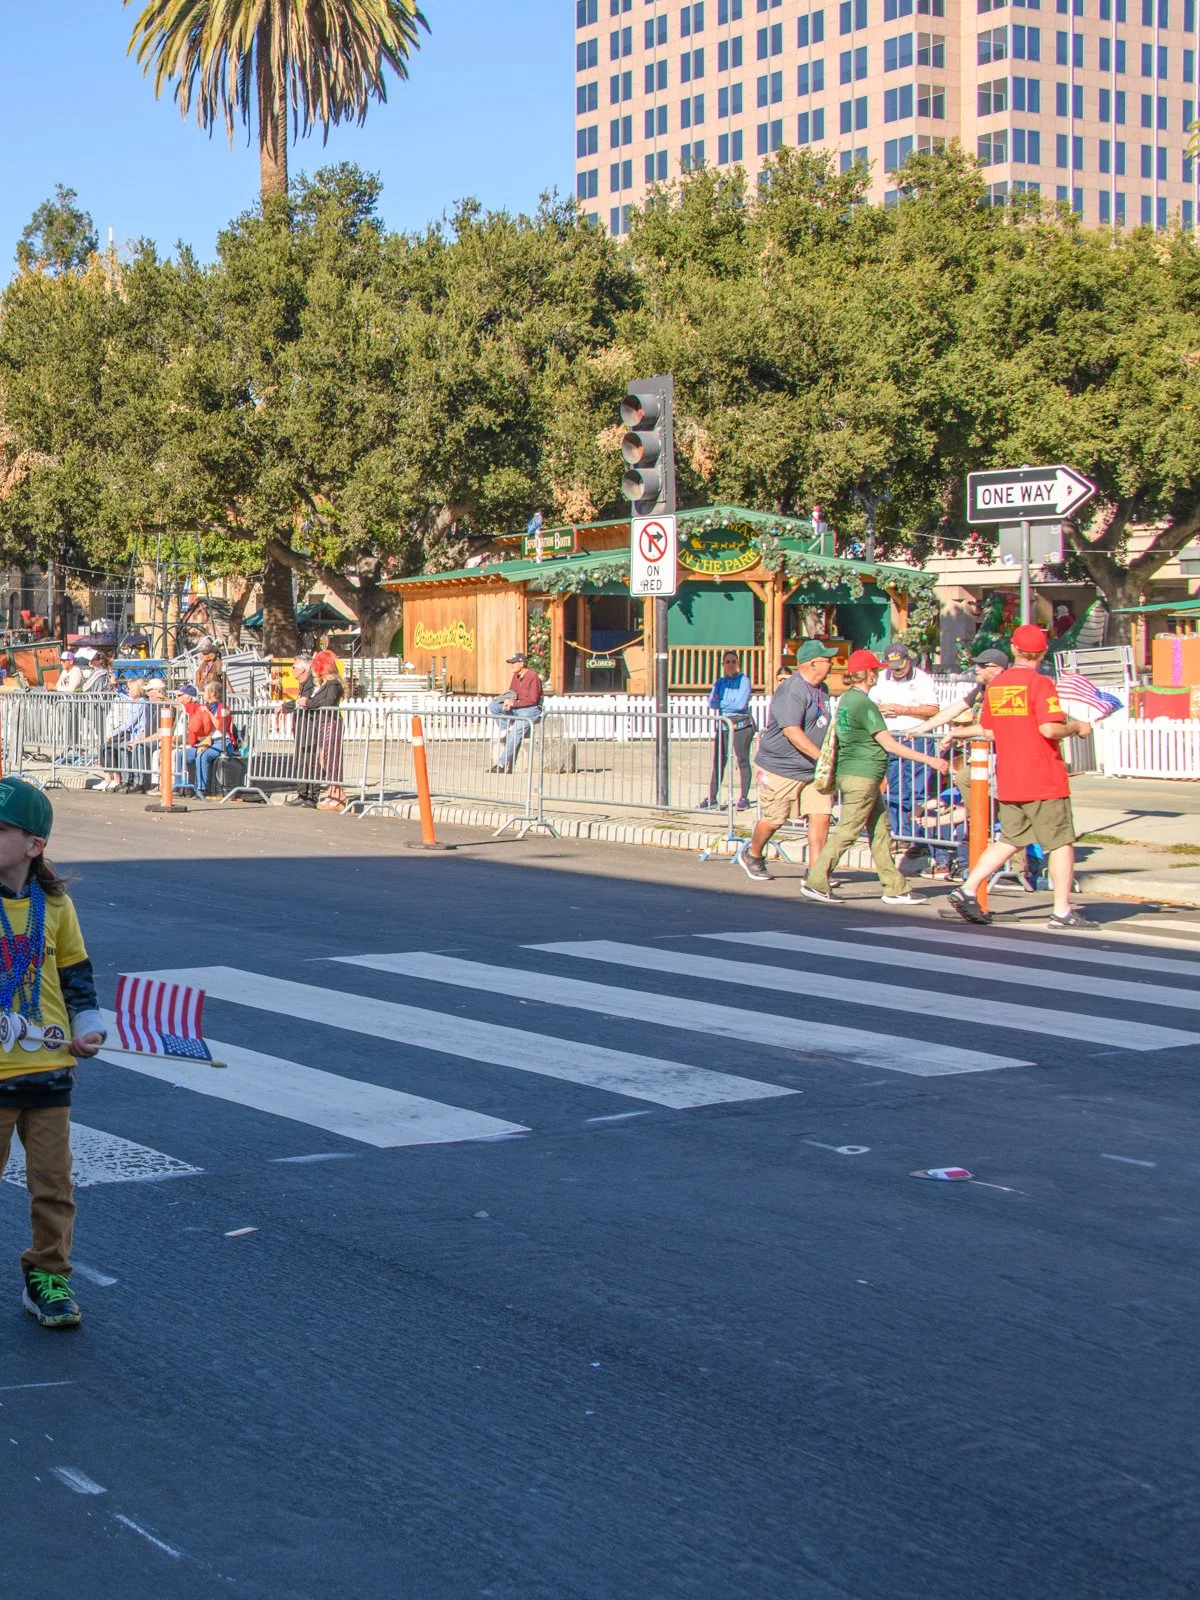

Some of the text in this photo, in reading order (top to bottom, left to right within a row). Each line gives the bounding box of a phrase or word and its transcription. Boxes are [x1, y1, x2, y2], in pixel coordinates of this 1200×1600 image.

[982, 483, 1055, 505] ONE WAY
[696, 559, 723, 573] THE
[724, 548, 759, 572] PARK
[647, 566, 660, 577] ON
[643, 580, 662, 591] RED
